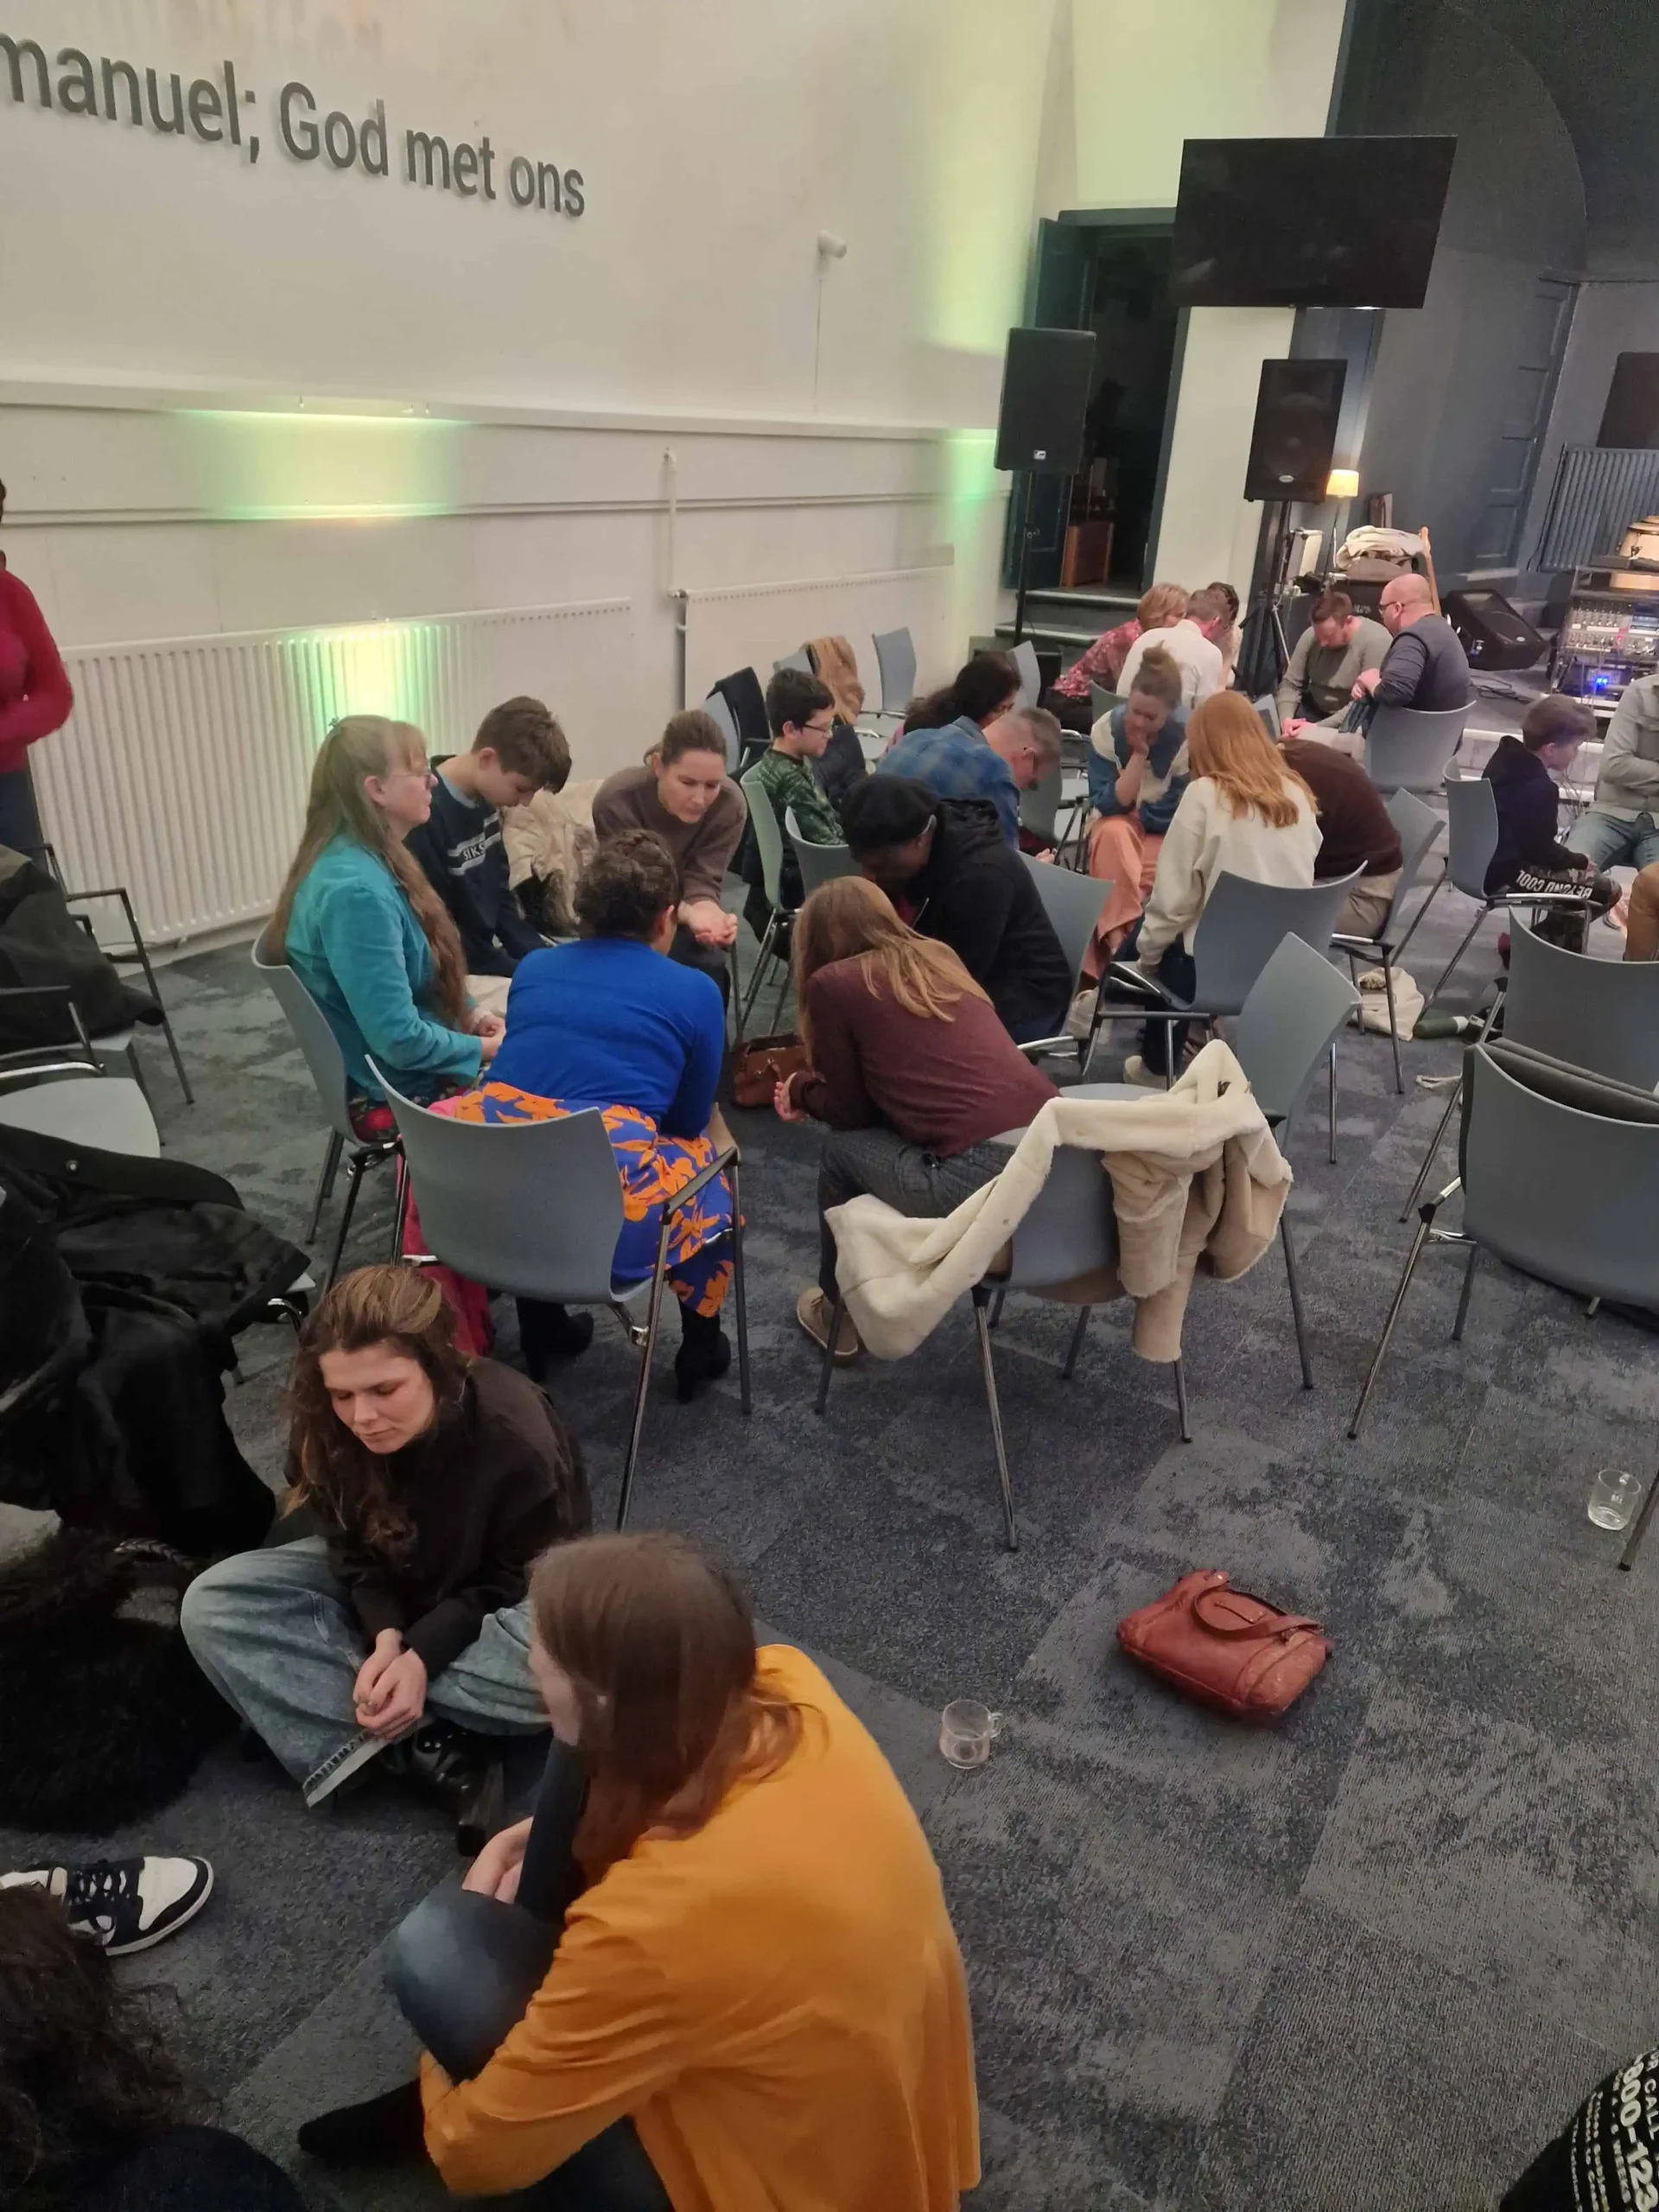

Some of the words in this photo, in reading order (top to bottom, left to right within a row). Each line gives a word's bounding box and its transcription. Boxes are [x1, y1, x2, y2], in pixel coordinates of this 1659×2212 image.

[0, 33, 259, 163] manuel;
[280, 82, 389, 176] God
[406, 129, 496, 200] met
[510, 156, 585, 217] ons
[1516, 870, 1542, 892] COOL
[1545, 881, 1592, 899] BEYOND
[1644, 2078, 1659, 2141] CALL
